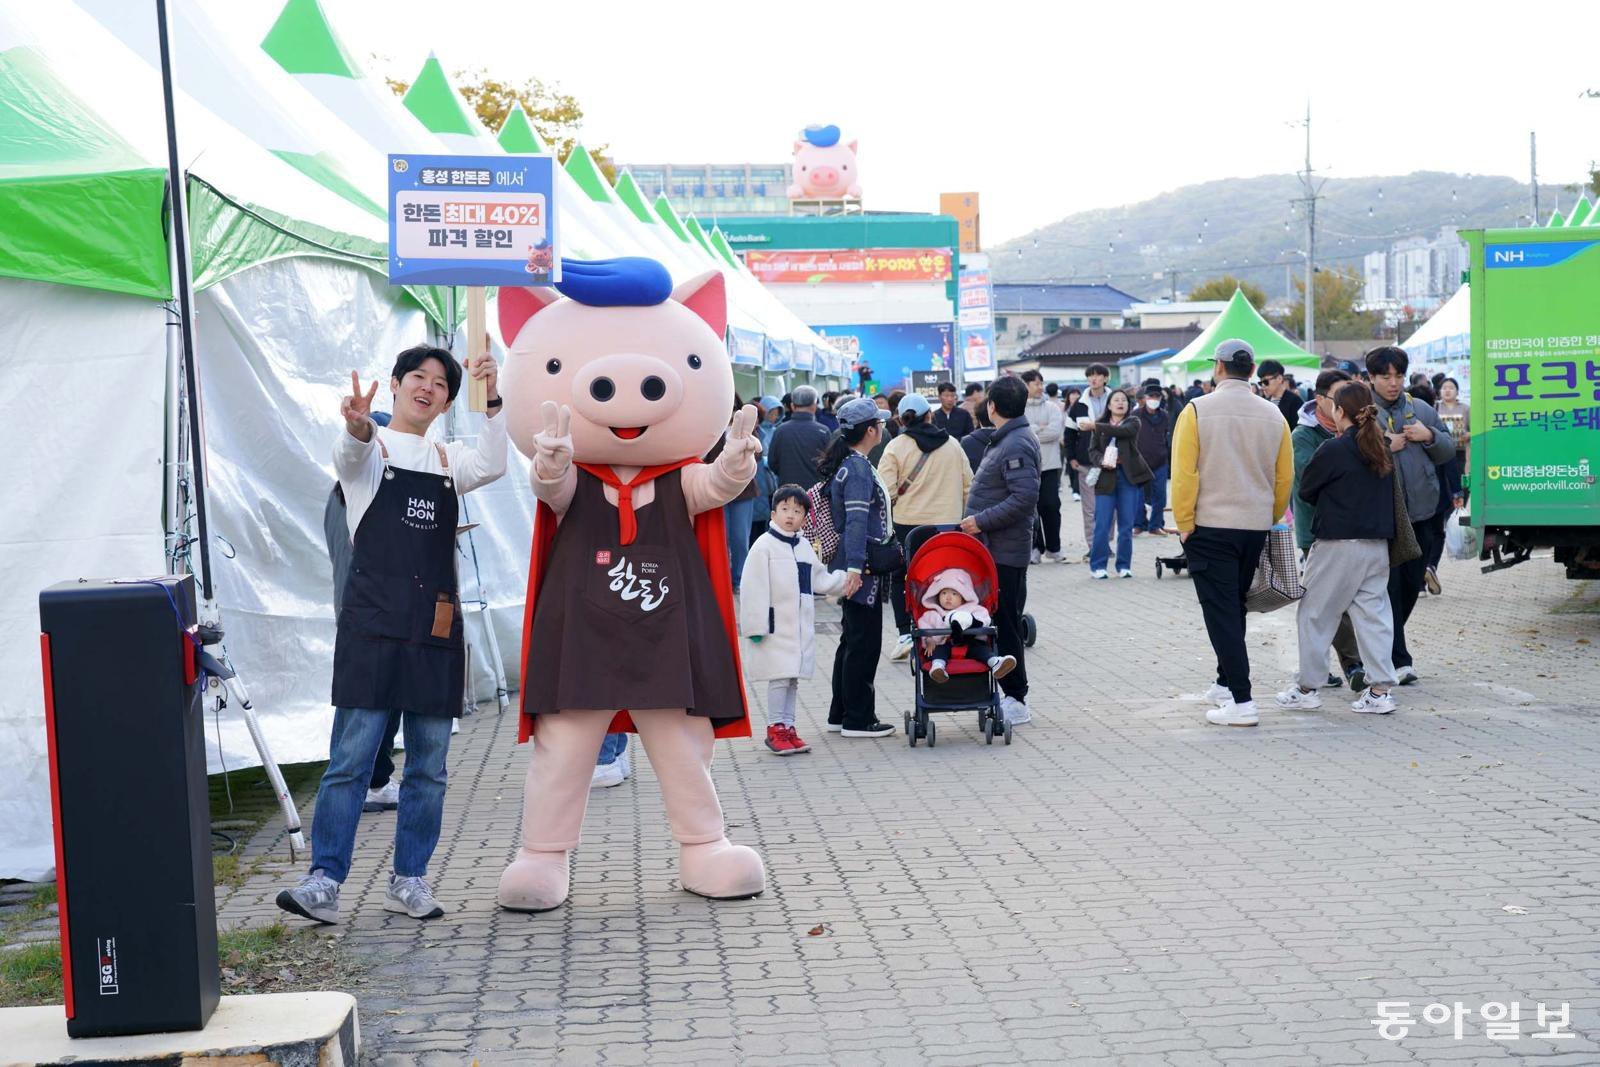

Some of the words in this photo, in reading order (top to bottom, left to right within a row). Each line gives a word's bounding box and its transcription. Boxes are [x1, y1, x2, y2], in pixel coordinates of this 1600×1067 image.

[422, 169, 449, 184] 홍성
[451, 170, 491, 185] 한돈존
[496, 171, 524, 187] 에서
[403, 202, 441, 223] 한돈
[445, 204, 486, 223] 최대
[490, 206, 538, 225] 40%
[428, 229, 468, 248] 파격
[474, 228, 513, 249] 할인
[1494, 250, 1524, 262] NH
[1502, 480, 1590, 493] www.porkvill.com
[408, 497, 435, 510] HAN
[407, 507, 435, 521] DON
